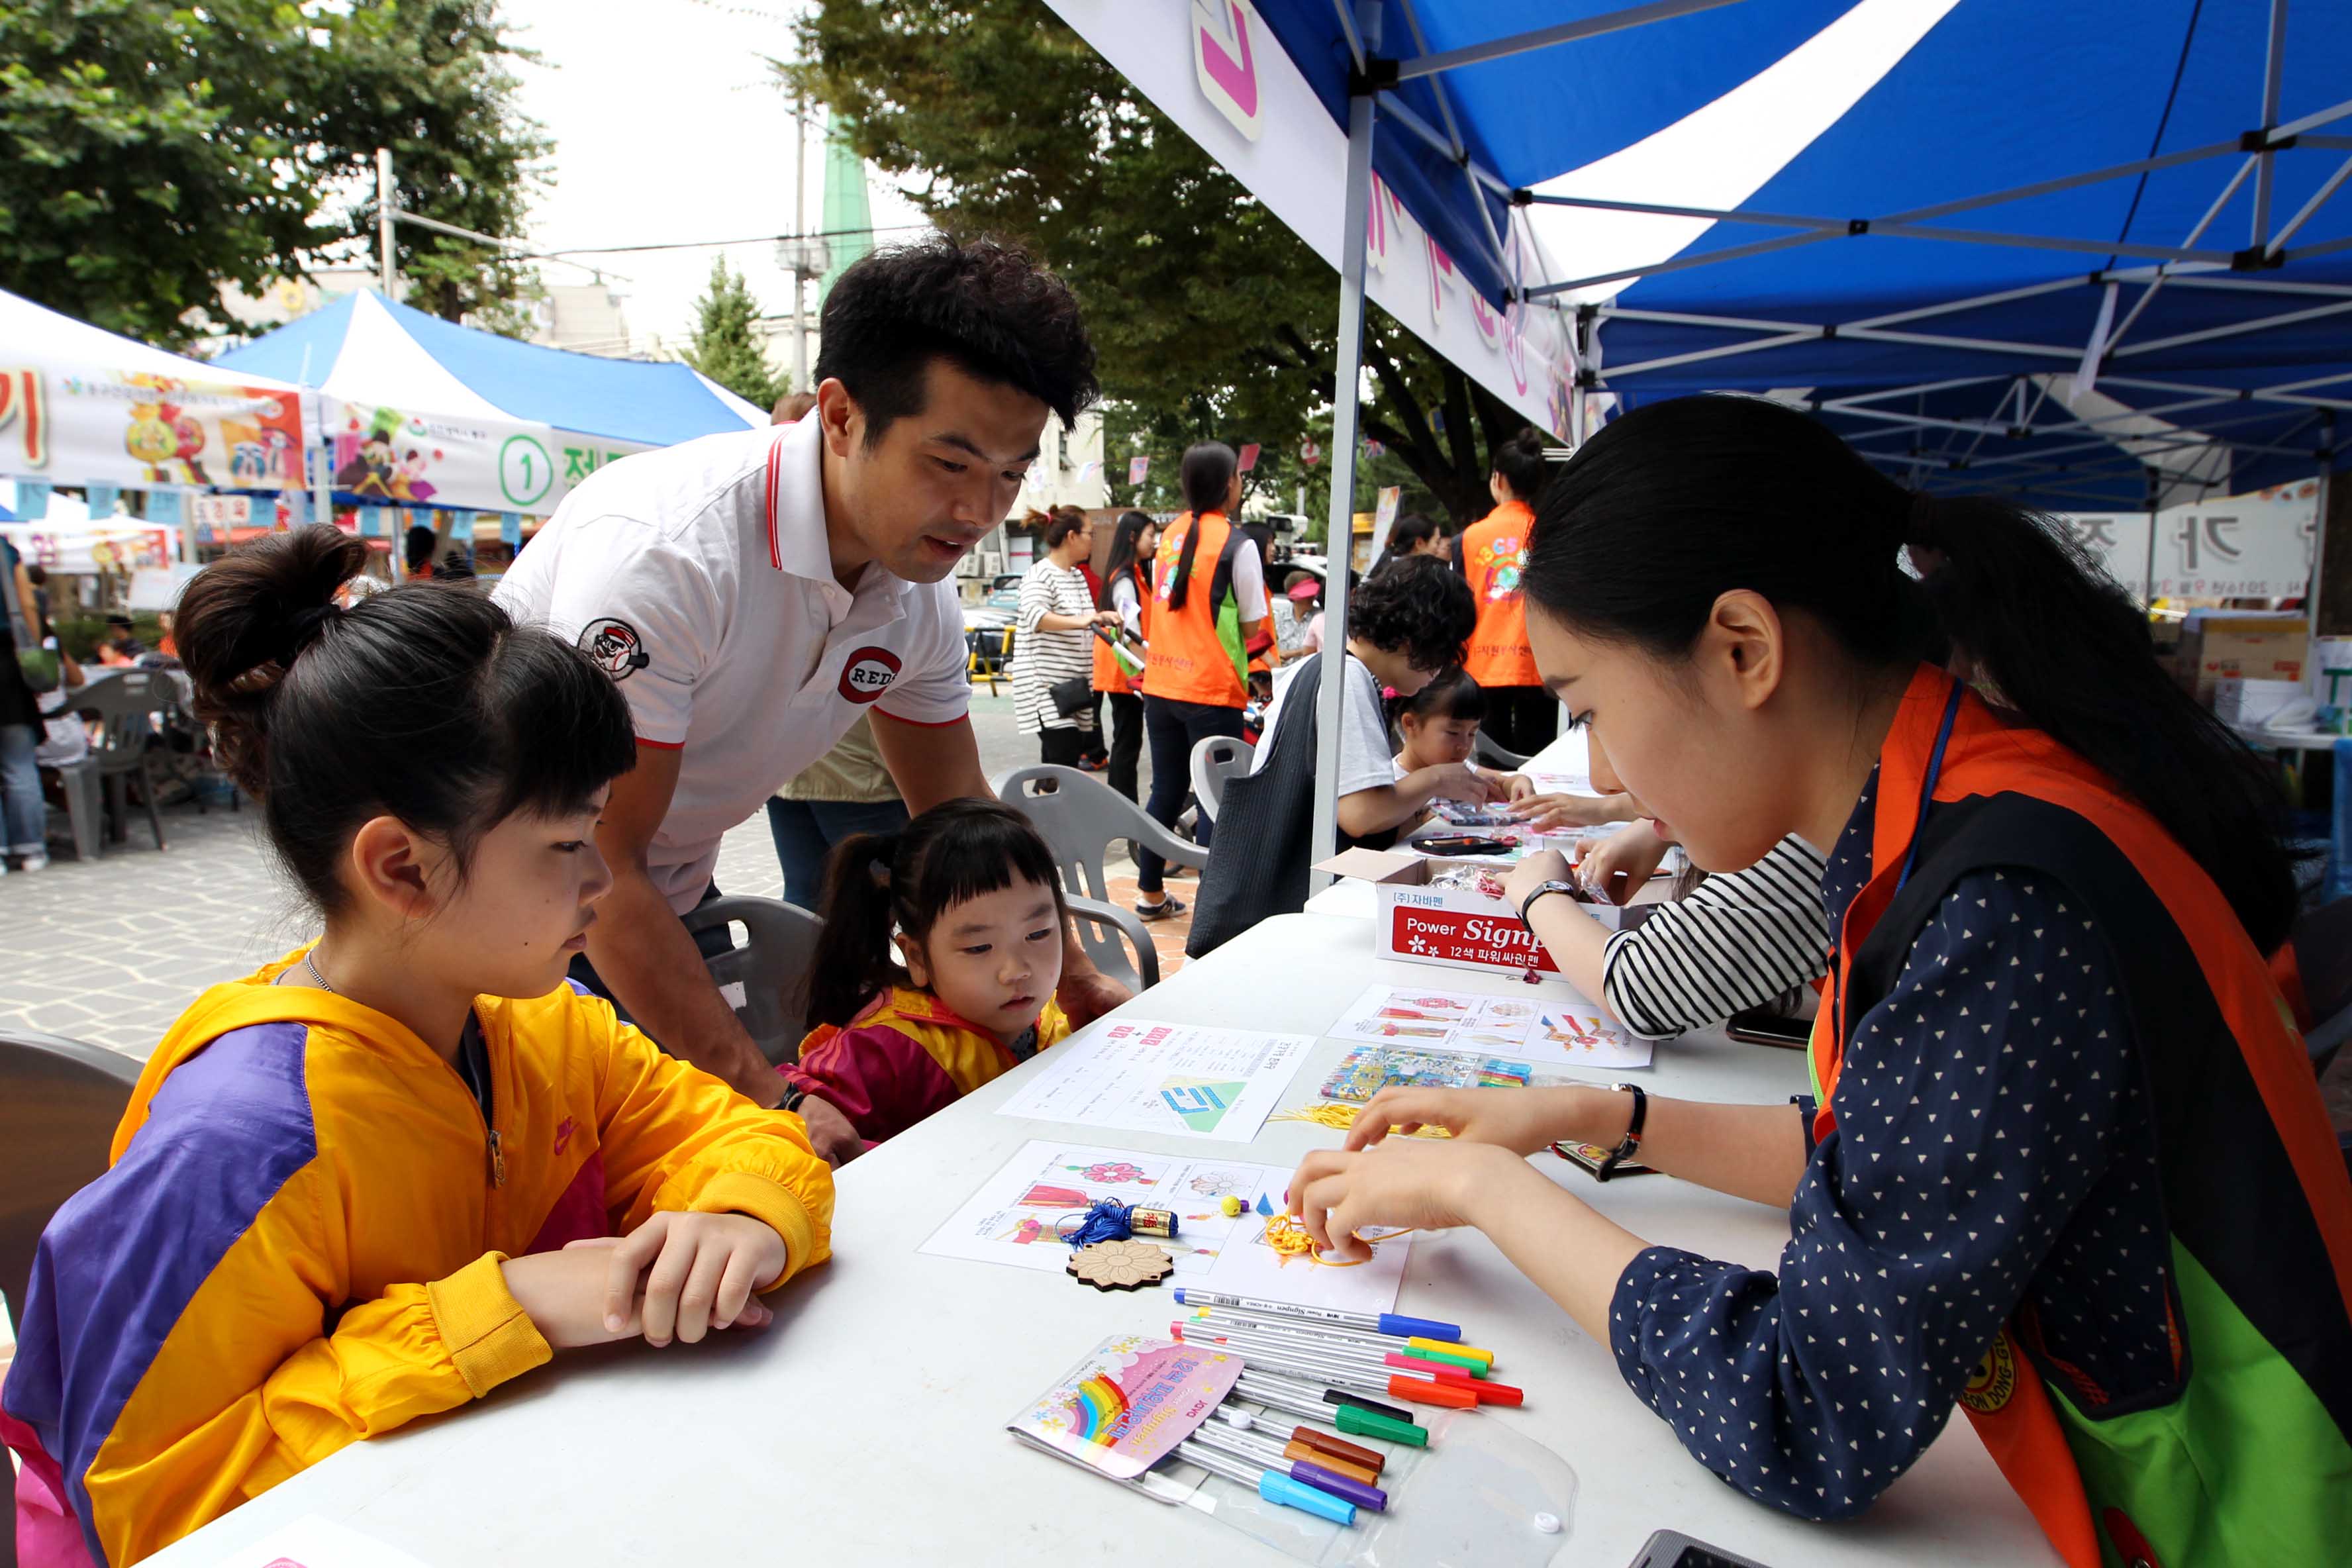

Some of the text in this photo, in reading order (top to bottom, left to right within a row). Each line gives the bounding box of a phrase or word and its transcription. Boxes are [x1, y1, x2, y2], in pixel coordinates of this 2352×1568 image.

[1407, 917, 1546, 954] Power Signp
[1450, 946, 1475, 960] 12색
[1276, 1304, 1305, 1316] Signpen
[1160, 1358, 1199, 1383] 12색
[1102, 1383, 1175, 1440] 파워싸인펜
[1128, 1404, 1177, 1446] Signpen
